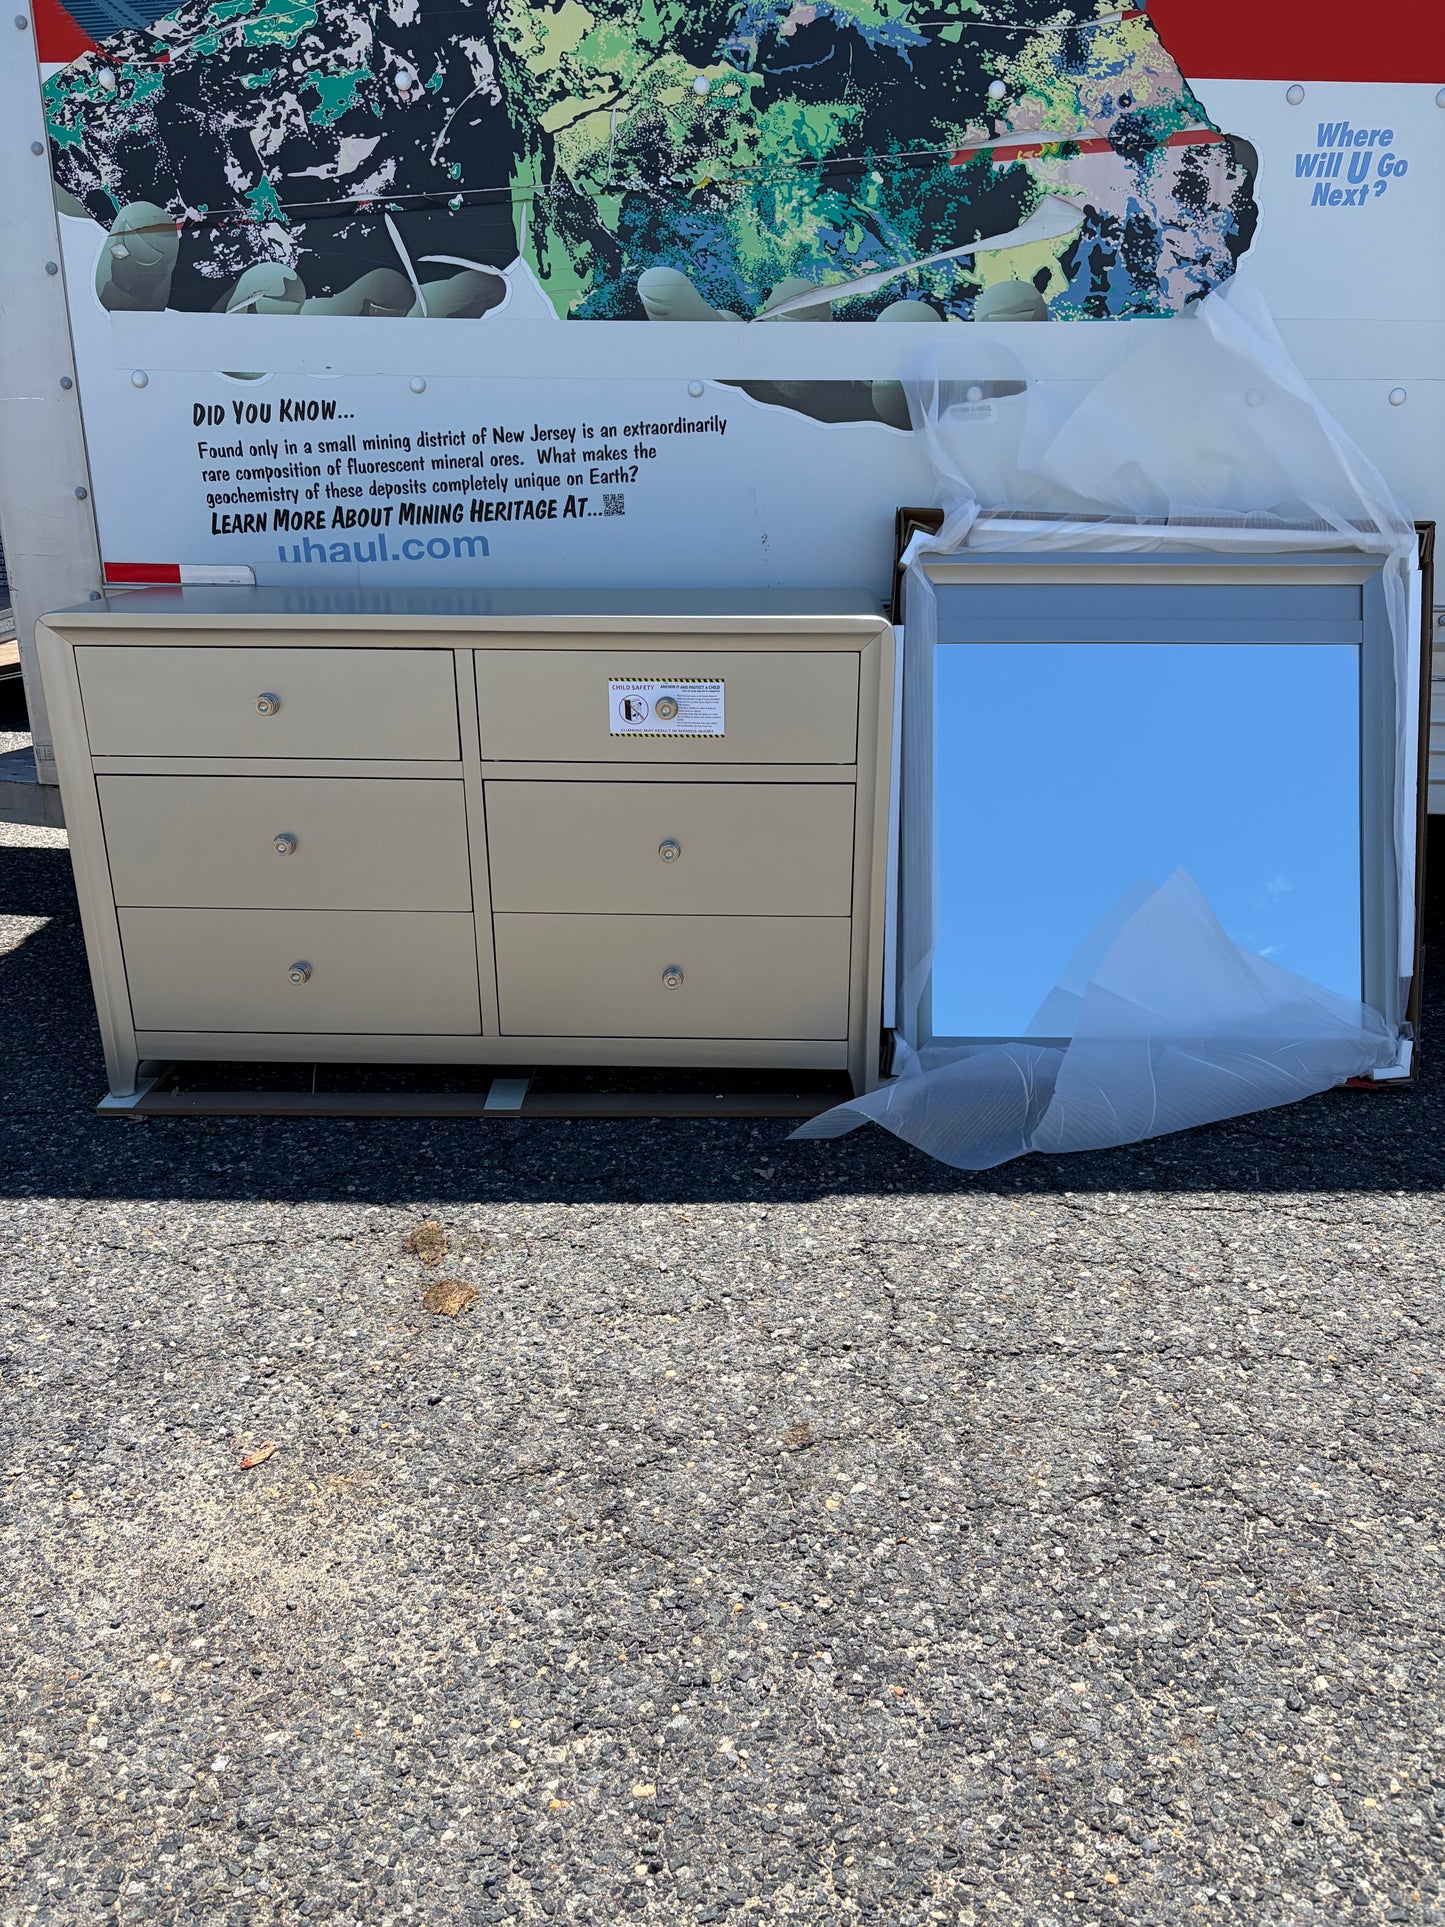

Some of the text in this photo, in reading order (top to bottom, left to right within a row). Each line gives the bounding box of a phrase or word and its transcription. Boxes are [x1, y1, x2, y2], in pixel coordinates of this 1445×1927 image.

[1317, 121, 1394, 147] Where
[1295, 151, 1408, 184] Will U Go
[198, 415, 727, 459] Found only in a small mining district of New Jersey is an extraordinarily
[202, 442, 657, 483] rare composition of fluorescent mineral ores. What makes the
[206, 465, 639, 508] geochemistry of these deposits completely unique on Earth?
[278, 533, 491, 563] uhaul.com
